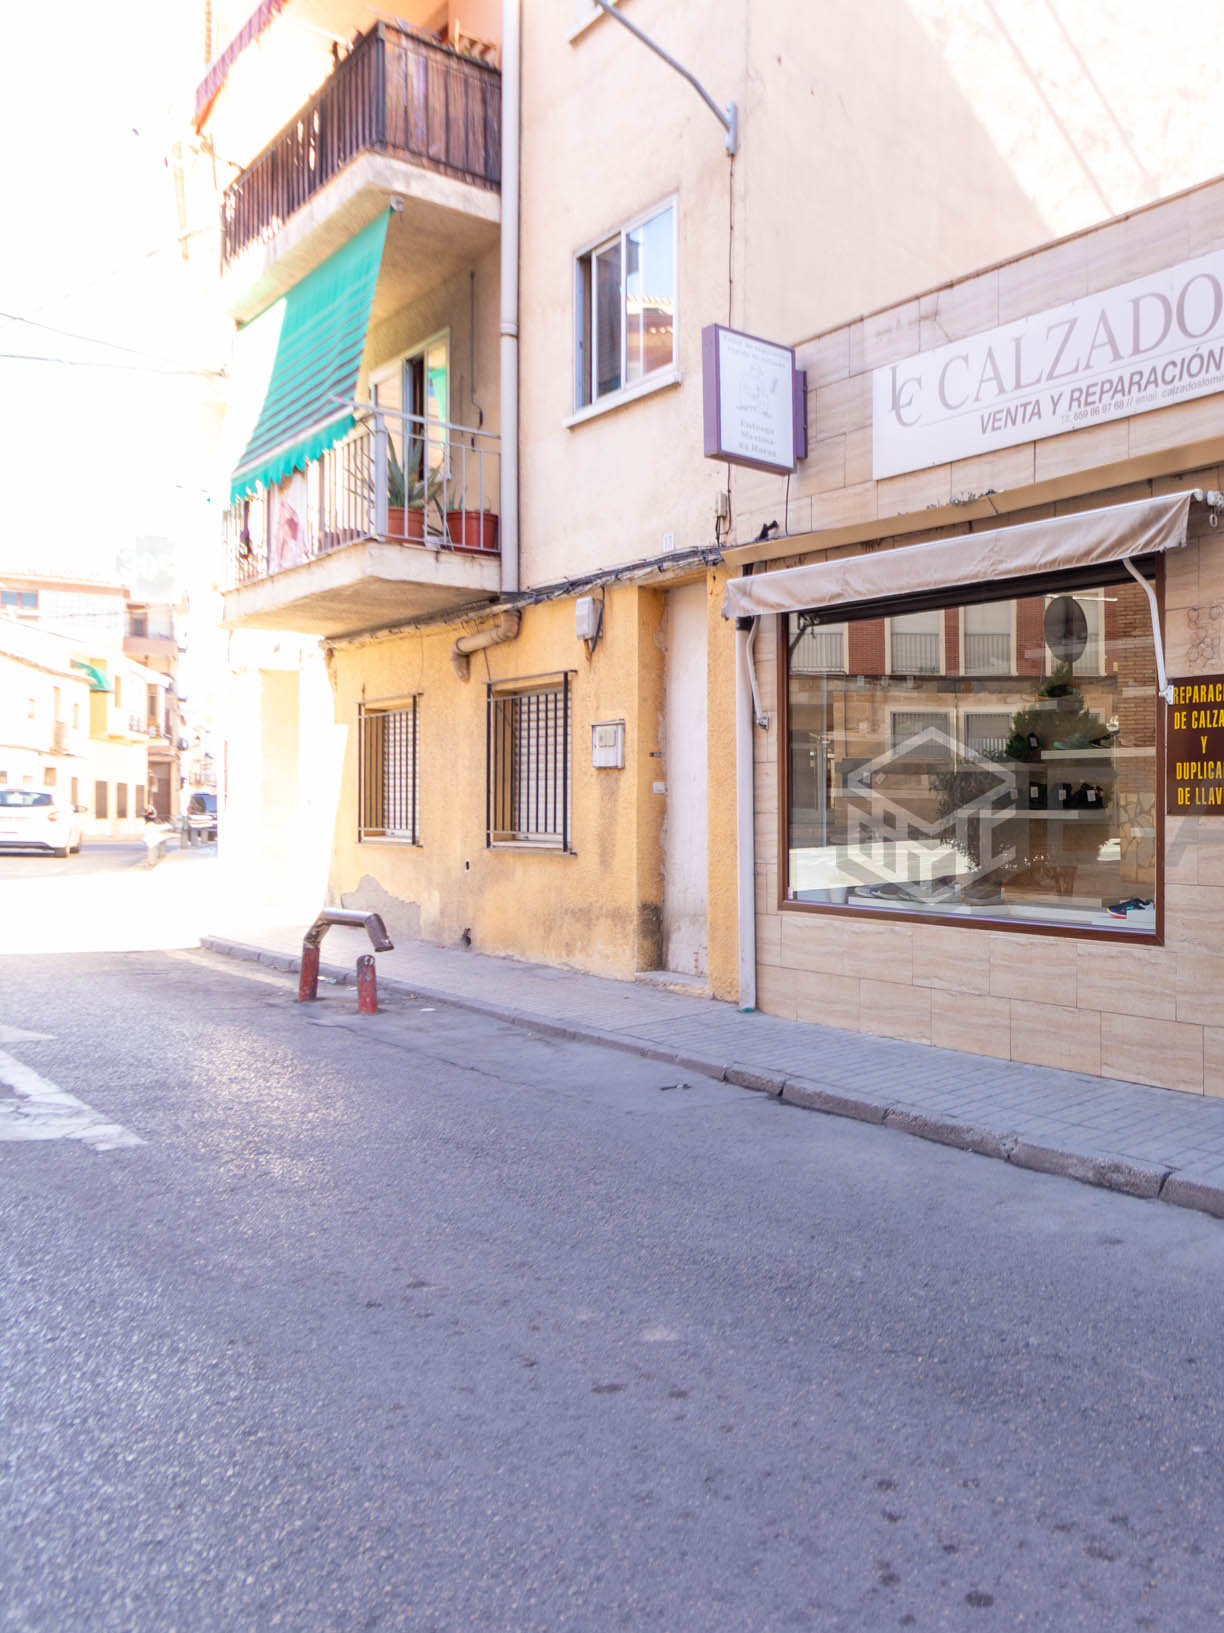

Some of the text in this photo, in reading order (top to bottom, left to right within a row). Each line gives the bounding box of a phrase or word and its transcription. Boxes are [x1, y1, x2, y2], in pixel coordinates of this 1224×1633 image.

[980, 399, 1042, 435] VENTA
[1050, 392, 1063, 416] Y
[1068, 346, 1224, 412] REPARACIÓN
[1174, 711, 1187, 729] DE
[1200, 736, 1207, 753] Y
[1178, 787, 1190, 805] DE
